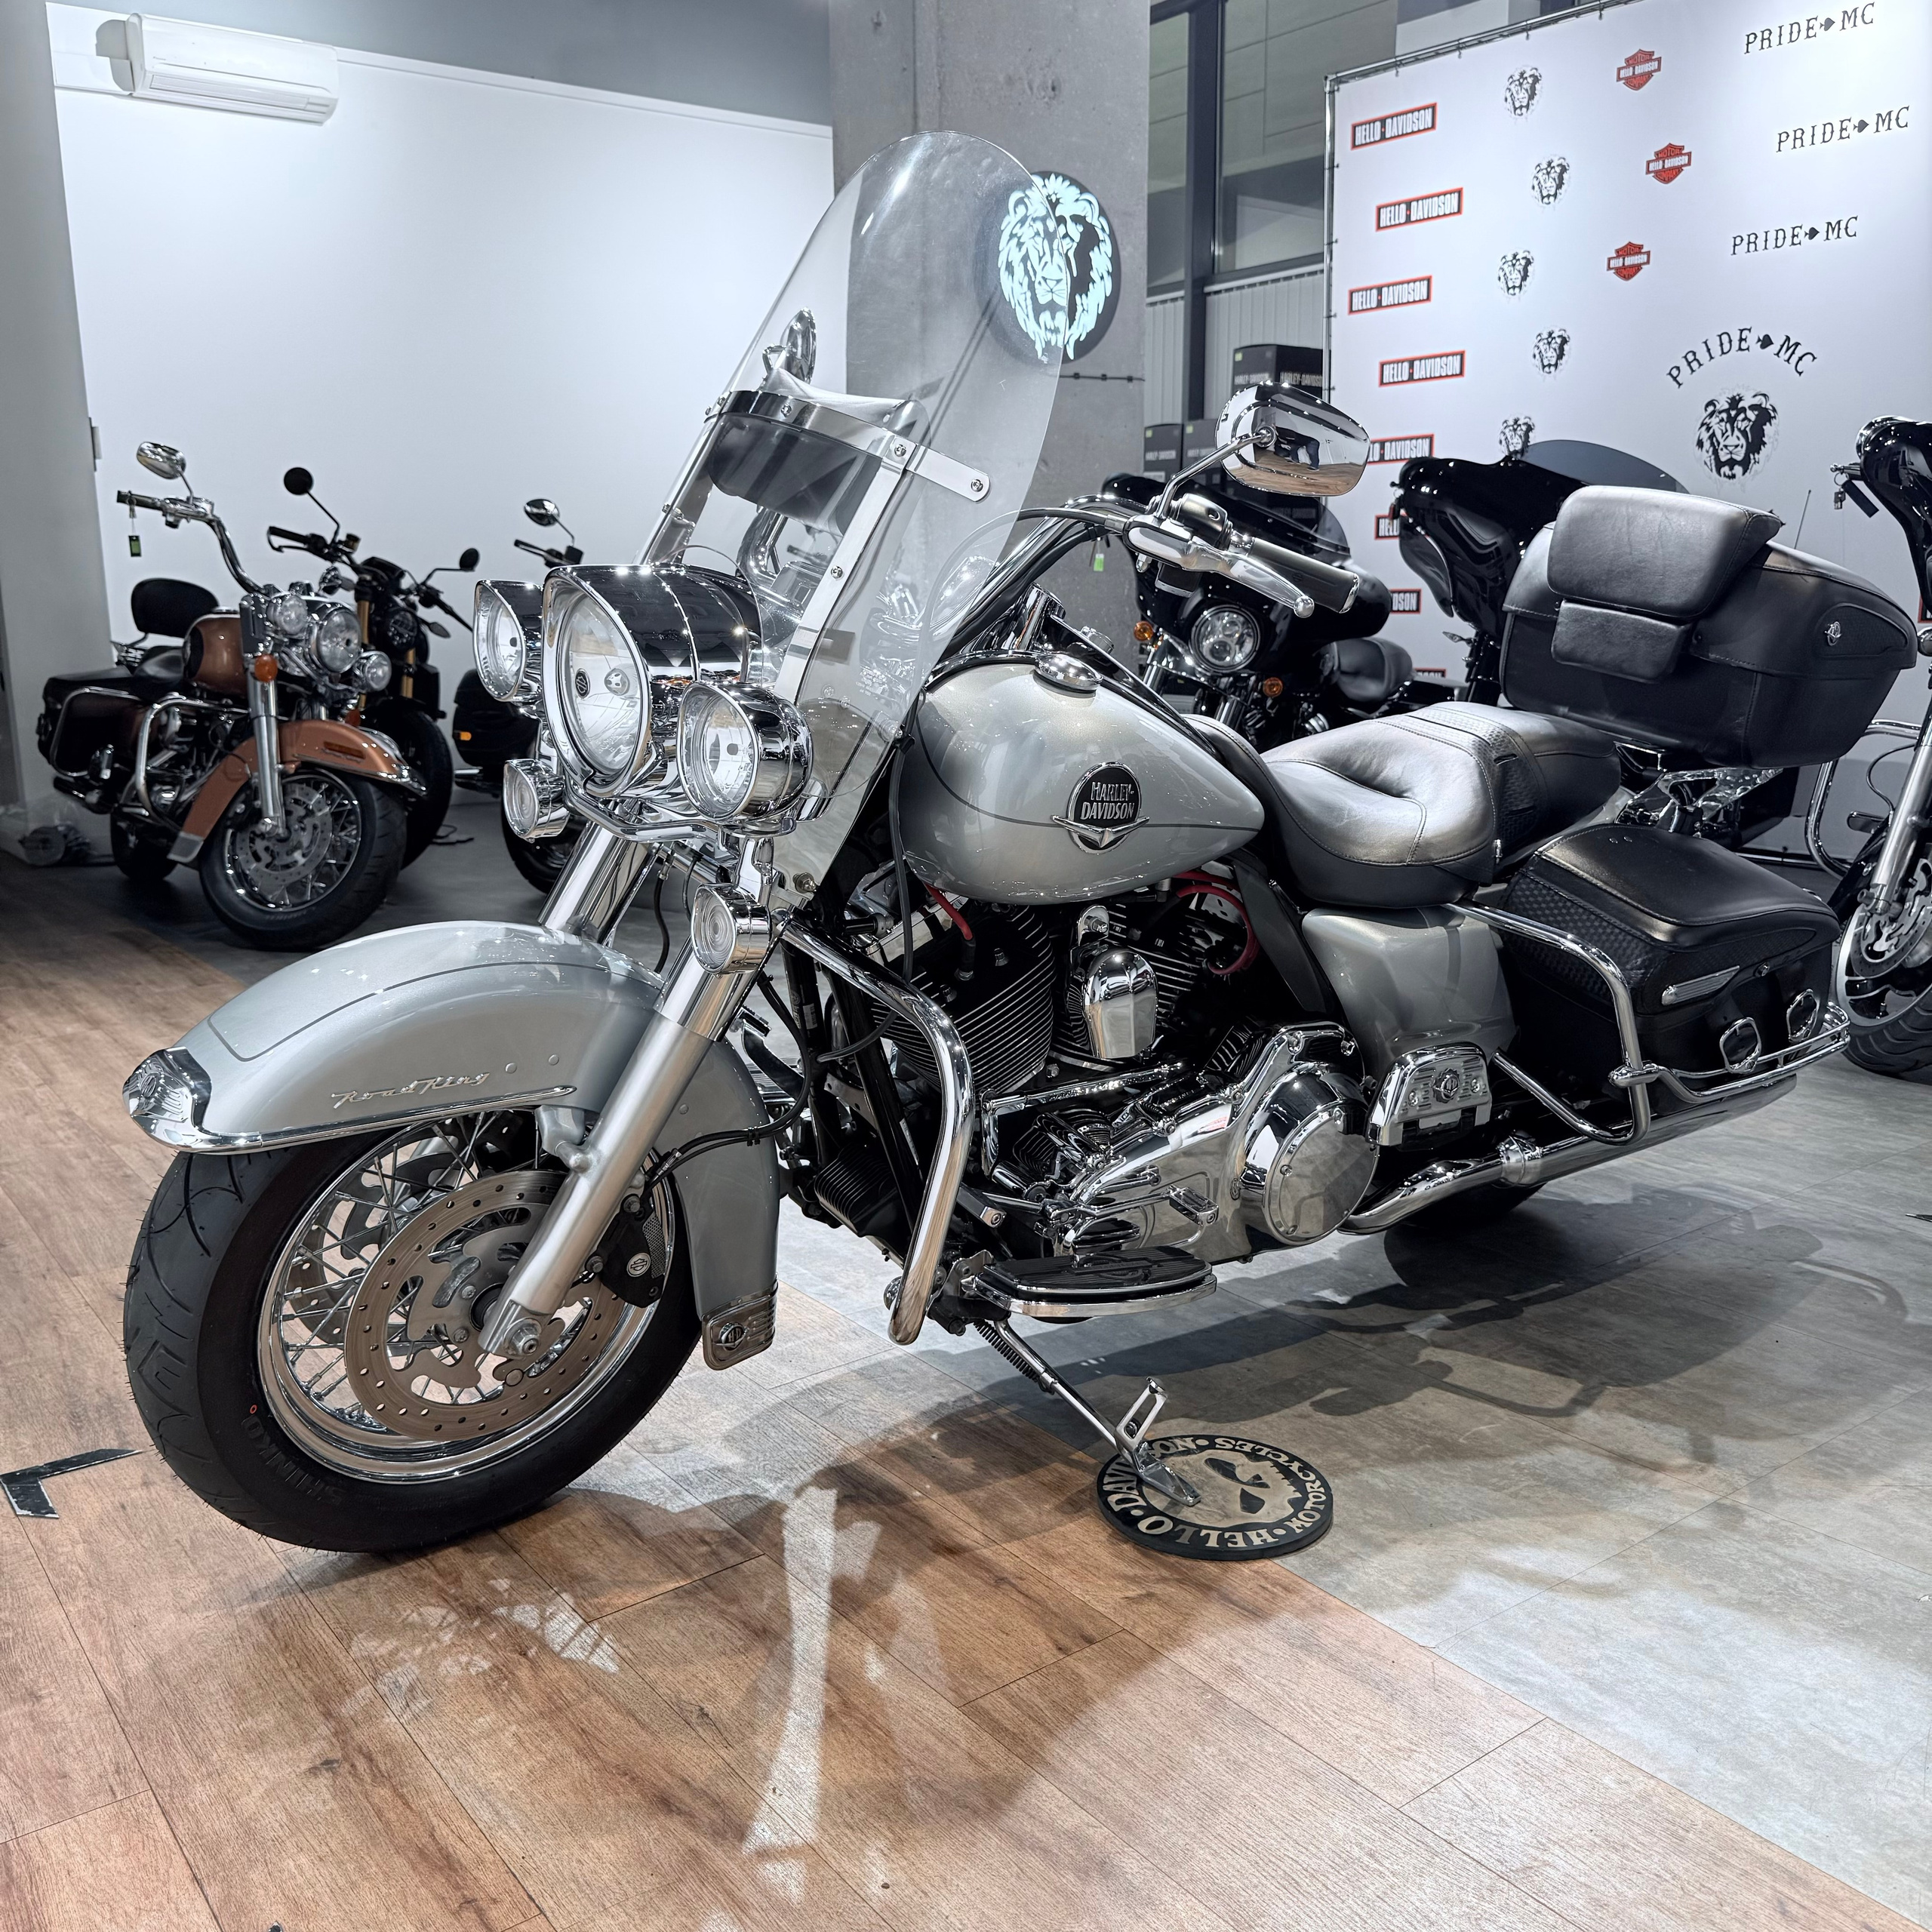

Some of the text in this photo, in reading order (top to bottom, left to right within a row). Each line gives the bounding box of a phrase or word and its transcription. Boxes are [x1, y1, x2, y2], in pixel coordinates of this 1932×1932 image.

[1743, 2, 1875, 55] PRIDE MC
[1355, 107, 1432, 146] HELLO DAVIDSON
[1776, 105, 1910, 152] PRIDE MC
[1380, 192, 1458, 227] HELLO DAVIDSON
[1730, 215, 1859, 256] PRIDE MC
[1352, 280, 1428, 312] HELLO DAVIDSON
[1383, 355, 1461, 384] HELLO DAVIDSON
[1666, 326, 1818, 389] PRIDE MC
[1383, 438, 1431, 461] DAVIDSON
[1378, 517, 1400, 537] HELL
[1080, 801, 1134, 820] DAVIDSON
[1214, 1437, 1327, 1534] MOTORCYCLES
[1137, 1515, 1280, 1547] HELLO
